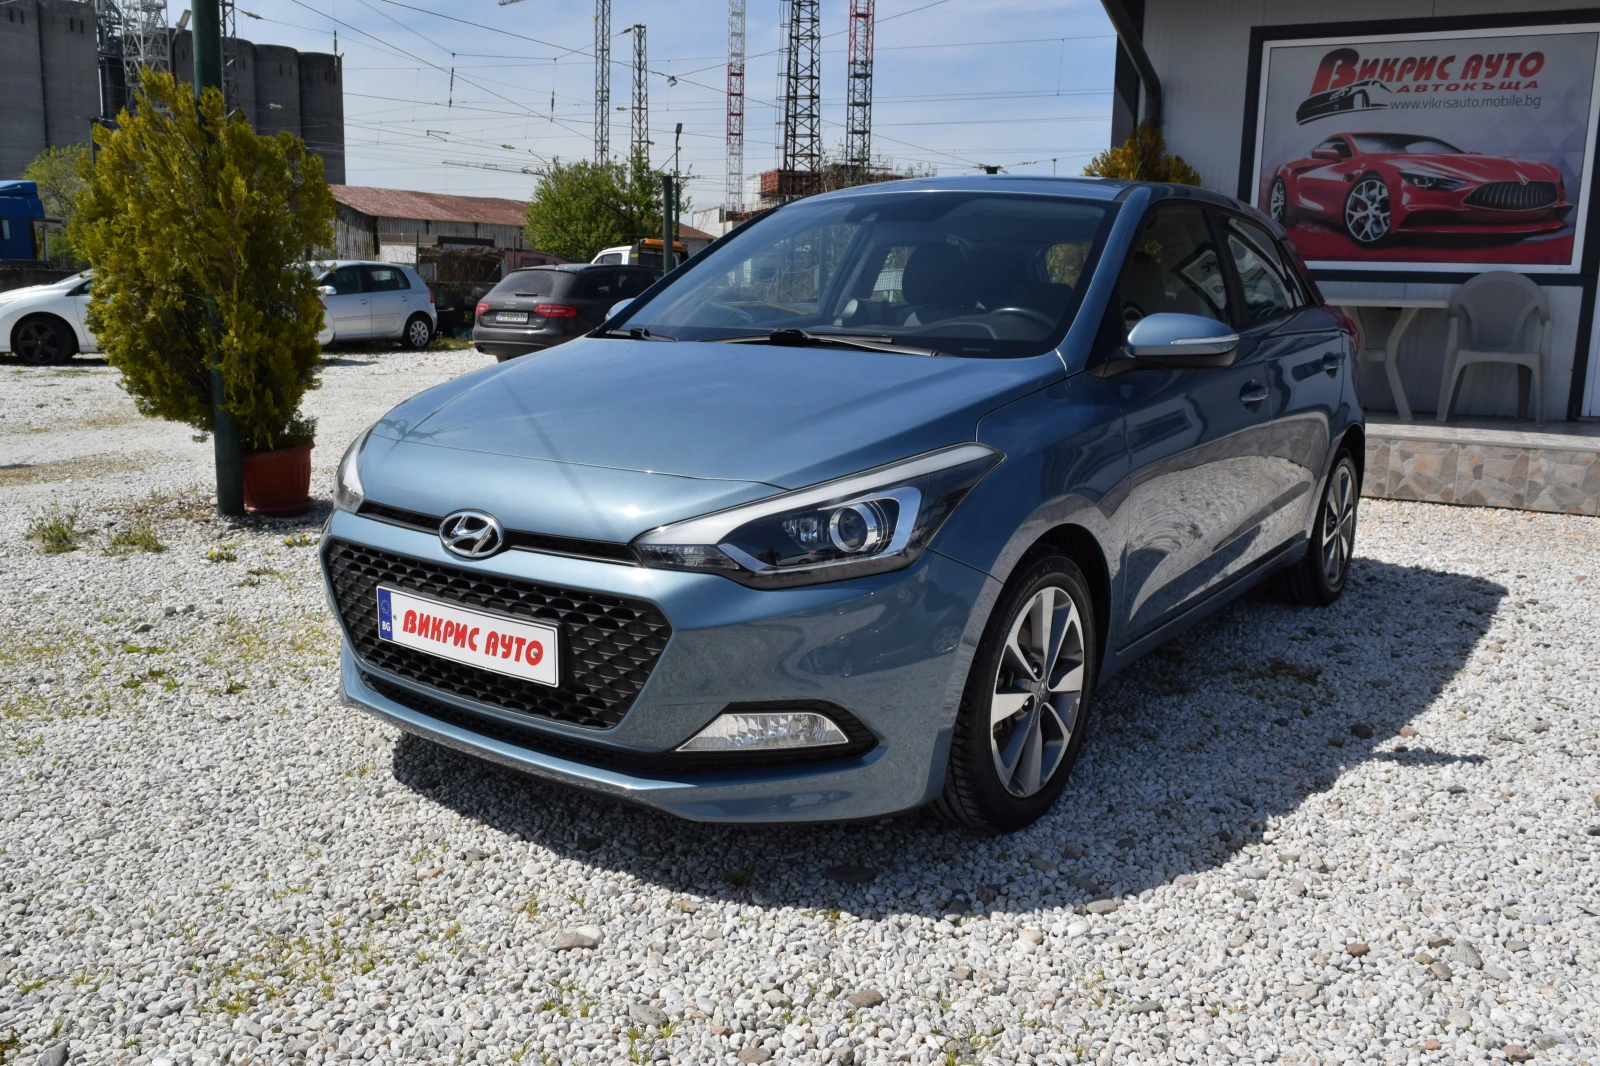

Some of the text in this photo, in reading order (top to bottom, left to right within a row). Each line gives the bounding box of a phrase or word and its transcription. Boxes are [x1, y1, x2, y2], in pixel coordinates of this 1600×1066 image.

[1309, 47, 1545, 95] ВИКРИС АУТО
[1395, 81, 1540, 93] АВТОКЪЩА
[1390, 94, 1542, 110] www.vikrisauto.mobile.bg
[381, 620, 391, 632] BG
[402, 609, 544, 667] ВИКРИС АУТО
